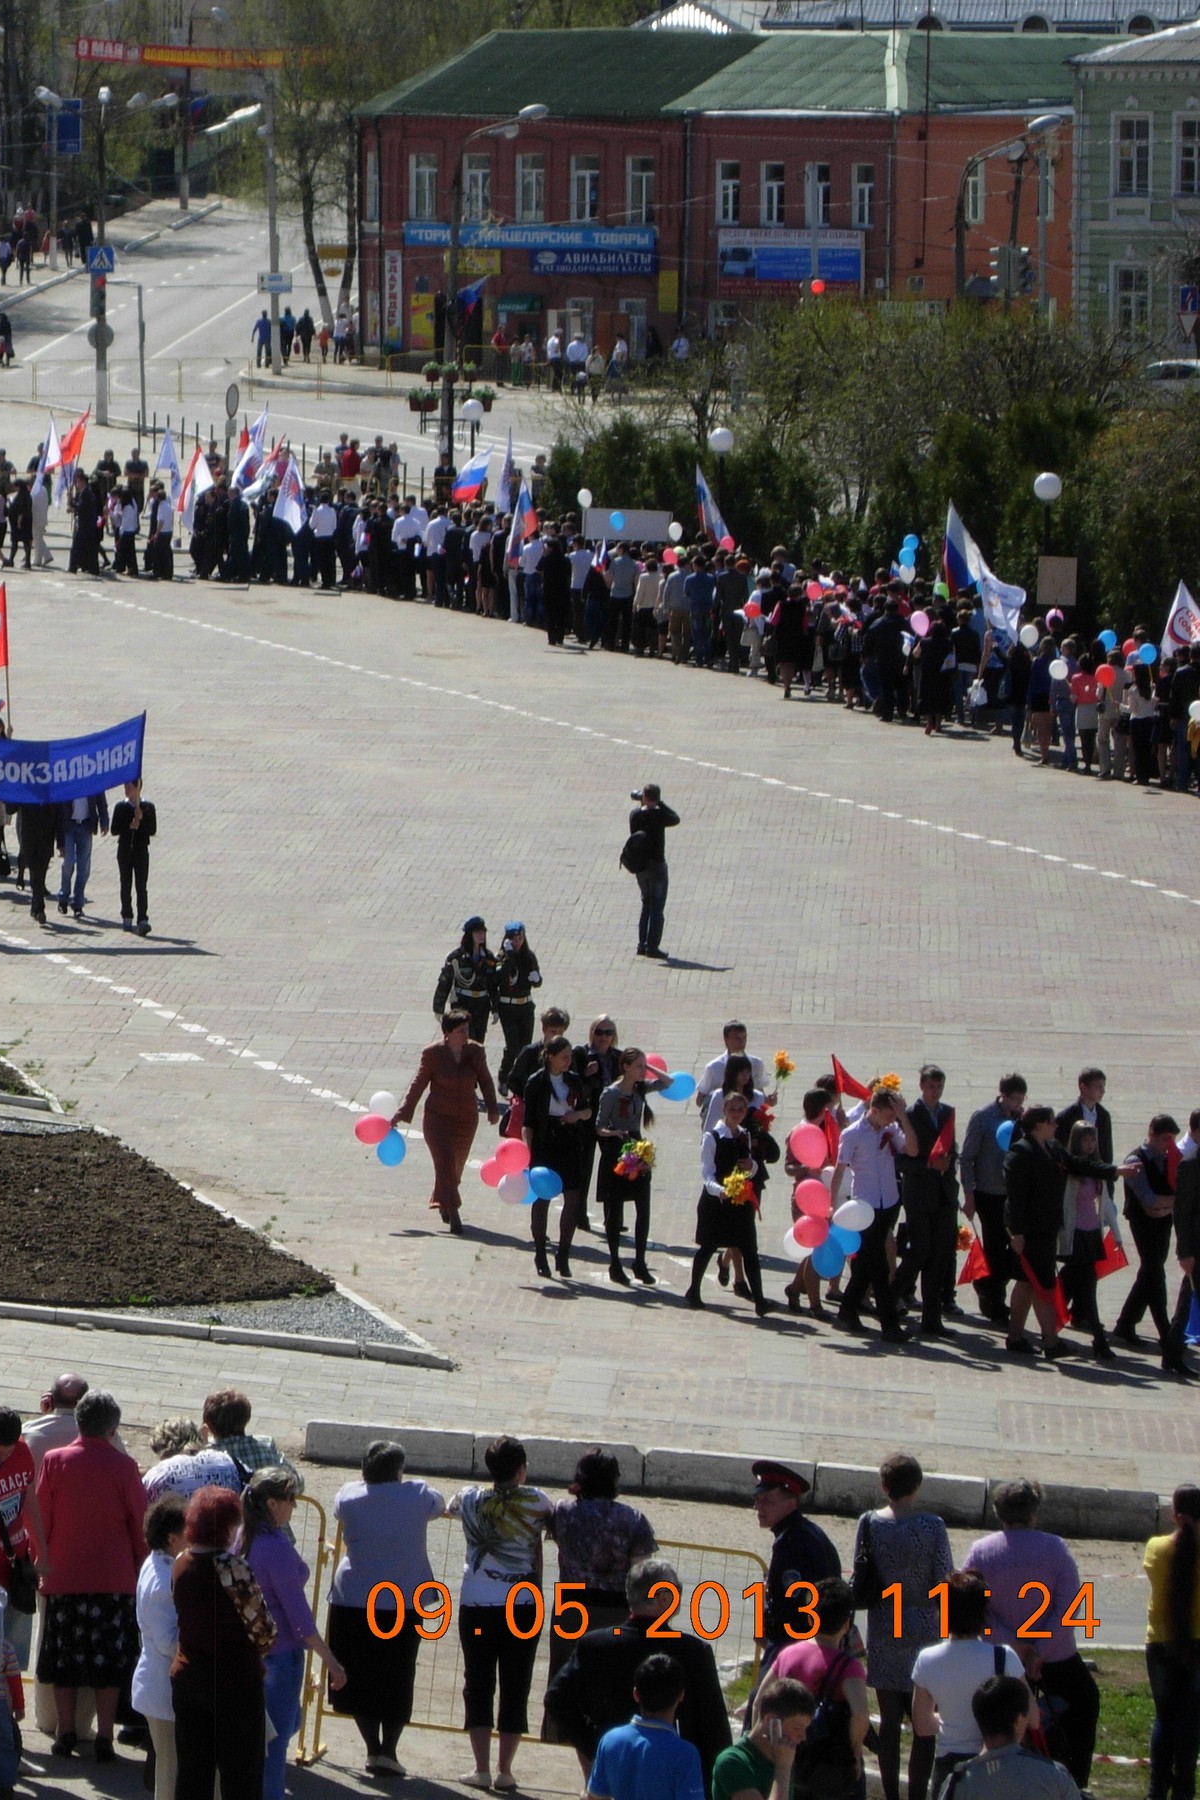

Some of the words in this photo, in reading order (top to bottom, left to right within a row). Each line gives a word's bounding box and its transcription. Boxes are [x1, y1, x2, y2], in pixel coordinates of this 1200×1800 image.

[478, 228, 583, 244] КАНЦЕЛЯРСКИЕ
[593, 230, 649, 245] ТОВАРЫ
[563, 252, 652, 264] АВИАБИЛЕТЫ
[620, 264, 652, 273] КАССЫ
